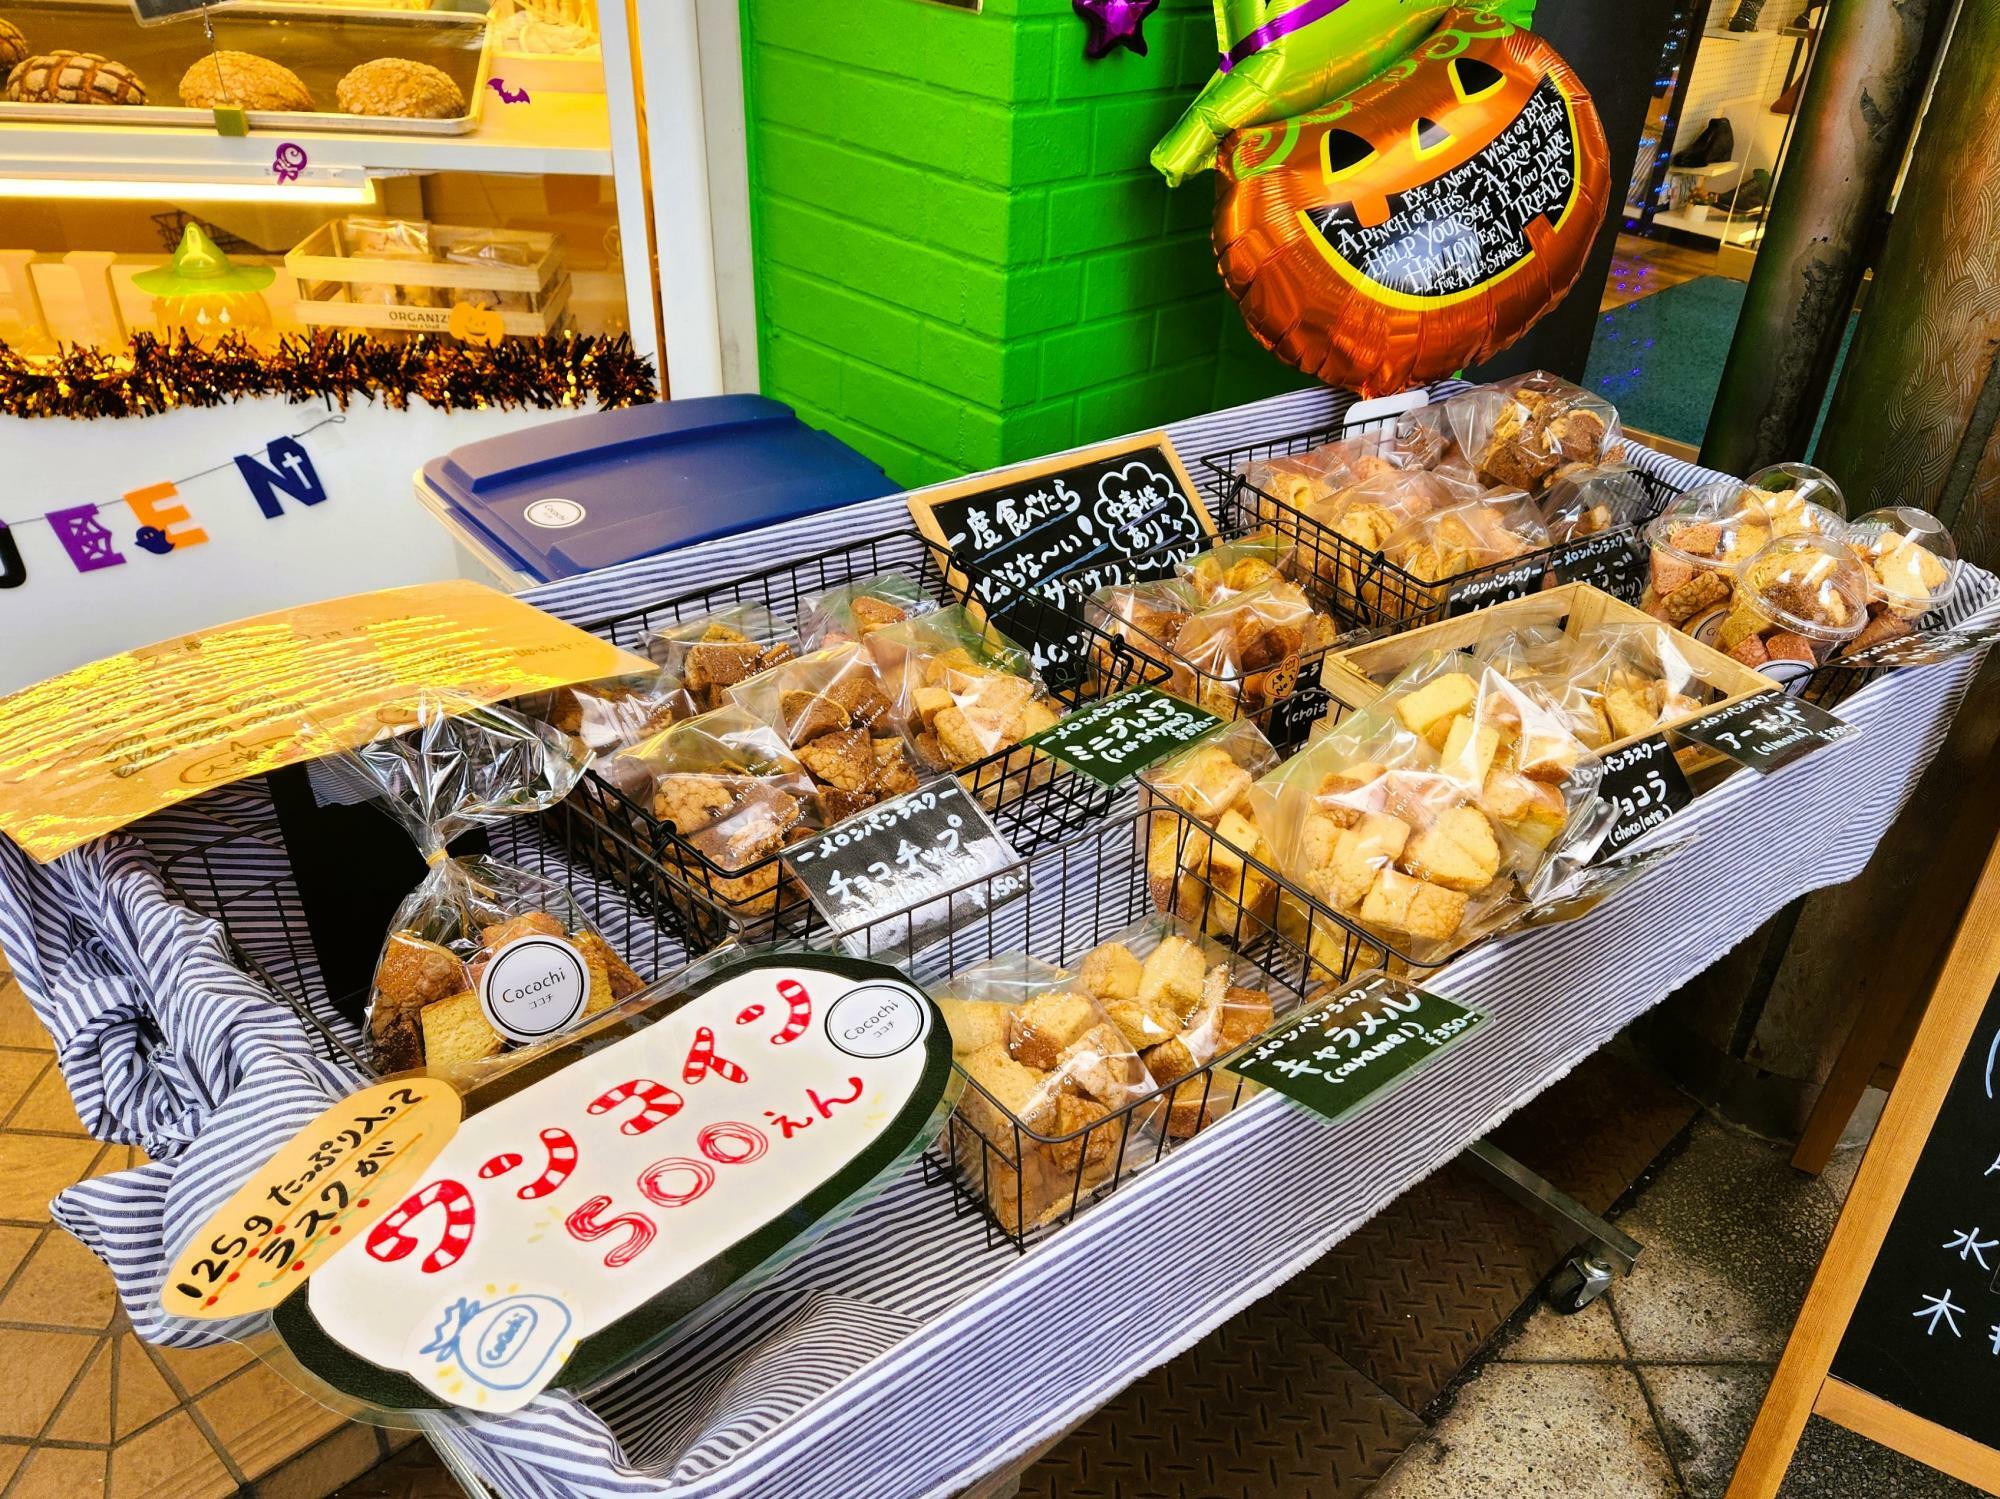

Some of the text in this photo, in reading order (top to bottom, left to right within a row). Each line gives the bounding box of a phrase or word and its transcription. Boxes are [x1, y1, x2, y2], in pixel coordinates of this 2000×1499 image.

[1401, 189, 1432, 210] EYE
[1522, 90, 1548, 128] BAT
[1337, 228, 1362, 255] A
[1483, 171, 1504, 193] A
[1537, 100, 1564, 138] THAT
[1363, 236, 1415, 278] HELP
[1413, 196, 1493, 256] YOURSELF
[1533, 129, 1571, 174] DARE
[1402, 156, 1570, 292] HALLOWEEN TREATS
[1456, 263, 1483, 287] ALL
[1486, 231, 1525, 273] SHARE!
[388, 311, 450, 324] ORGANIZ
[948, 479, 1081, 550] 一度食べたら
[1106, 484, 1165, 521] 中毒性
[1127, 518, 1163, 550] あり
[1715, 702, 1806, 750] アーモンド
[1752, 726, 1814, 756] (almond)
[1608, 804, 1674, 847] (chocolate)
[825, 814, 963, 905] チョコチップ
[528, 993, 554, 1010] ココチ
[873, 1020, 895, 1038] ココチ
[1272, 992, 1422, 1079] キャラメル
[1323, 1021, 1425, 1084] (caramel)
[365, 978, 814, 1274] ワンコイン
[1942, 1226, 2000, 1271] 水
[1912, 1288, 1967, 1338] 木
